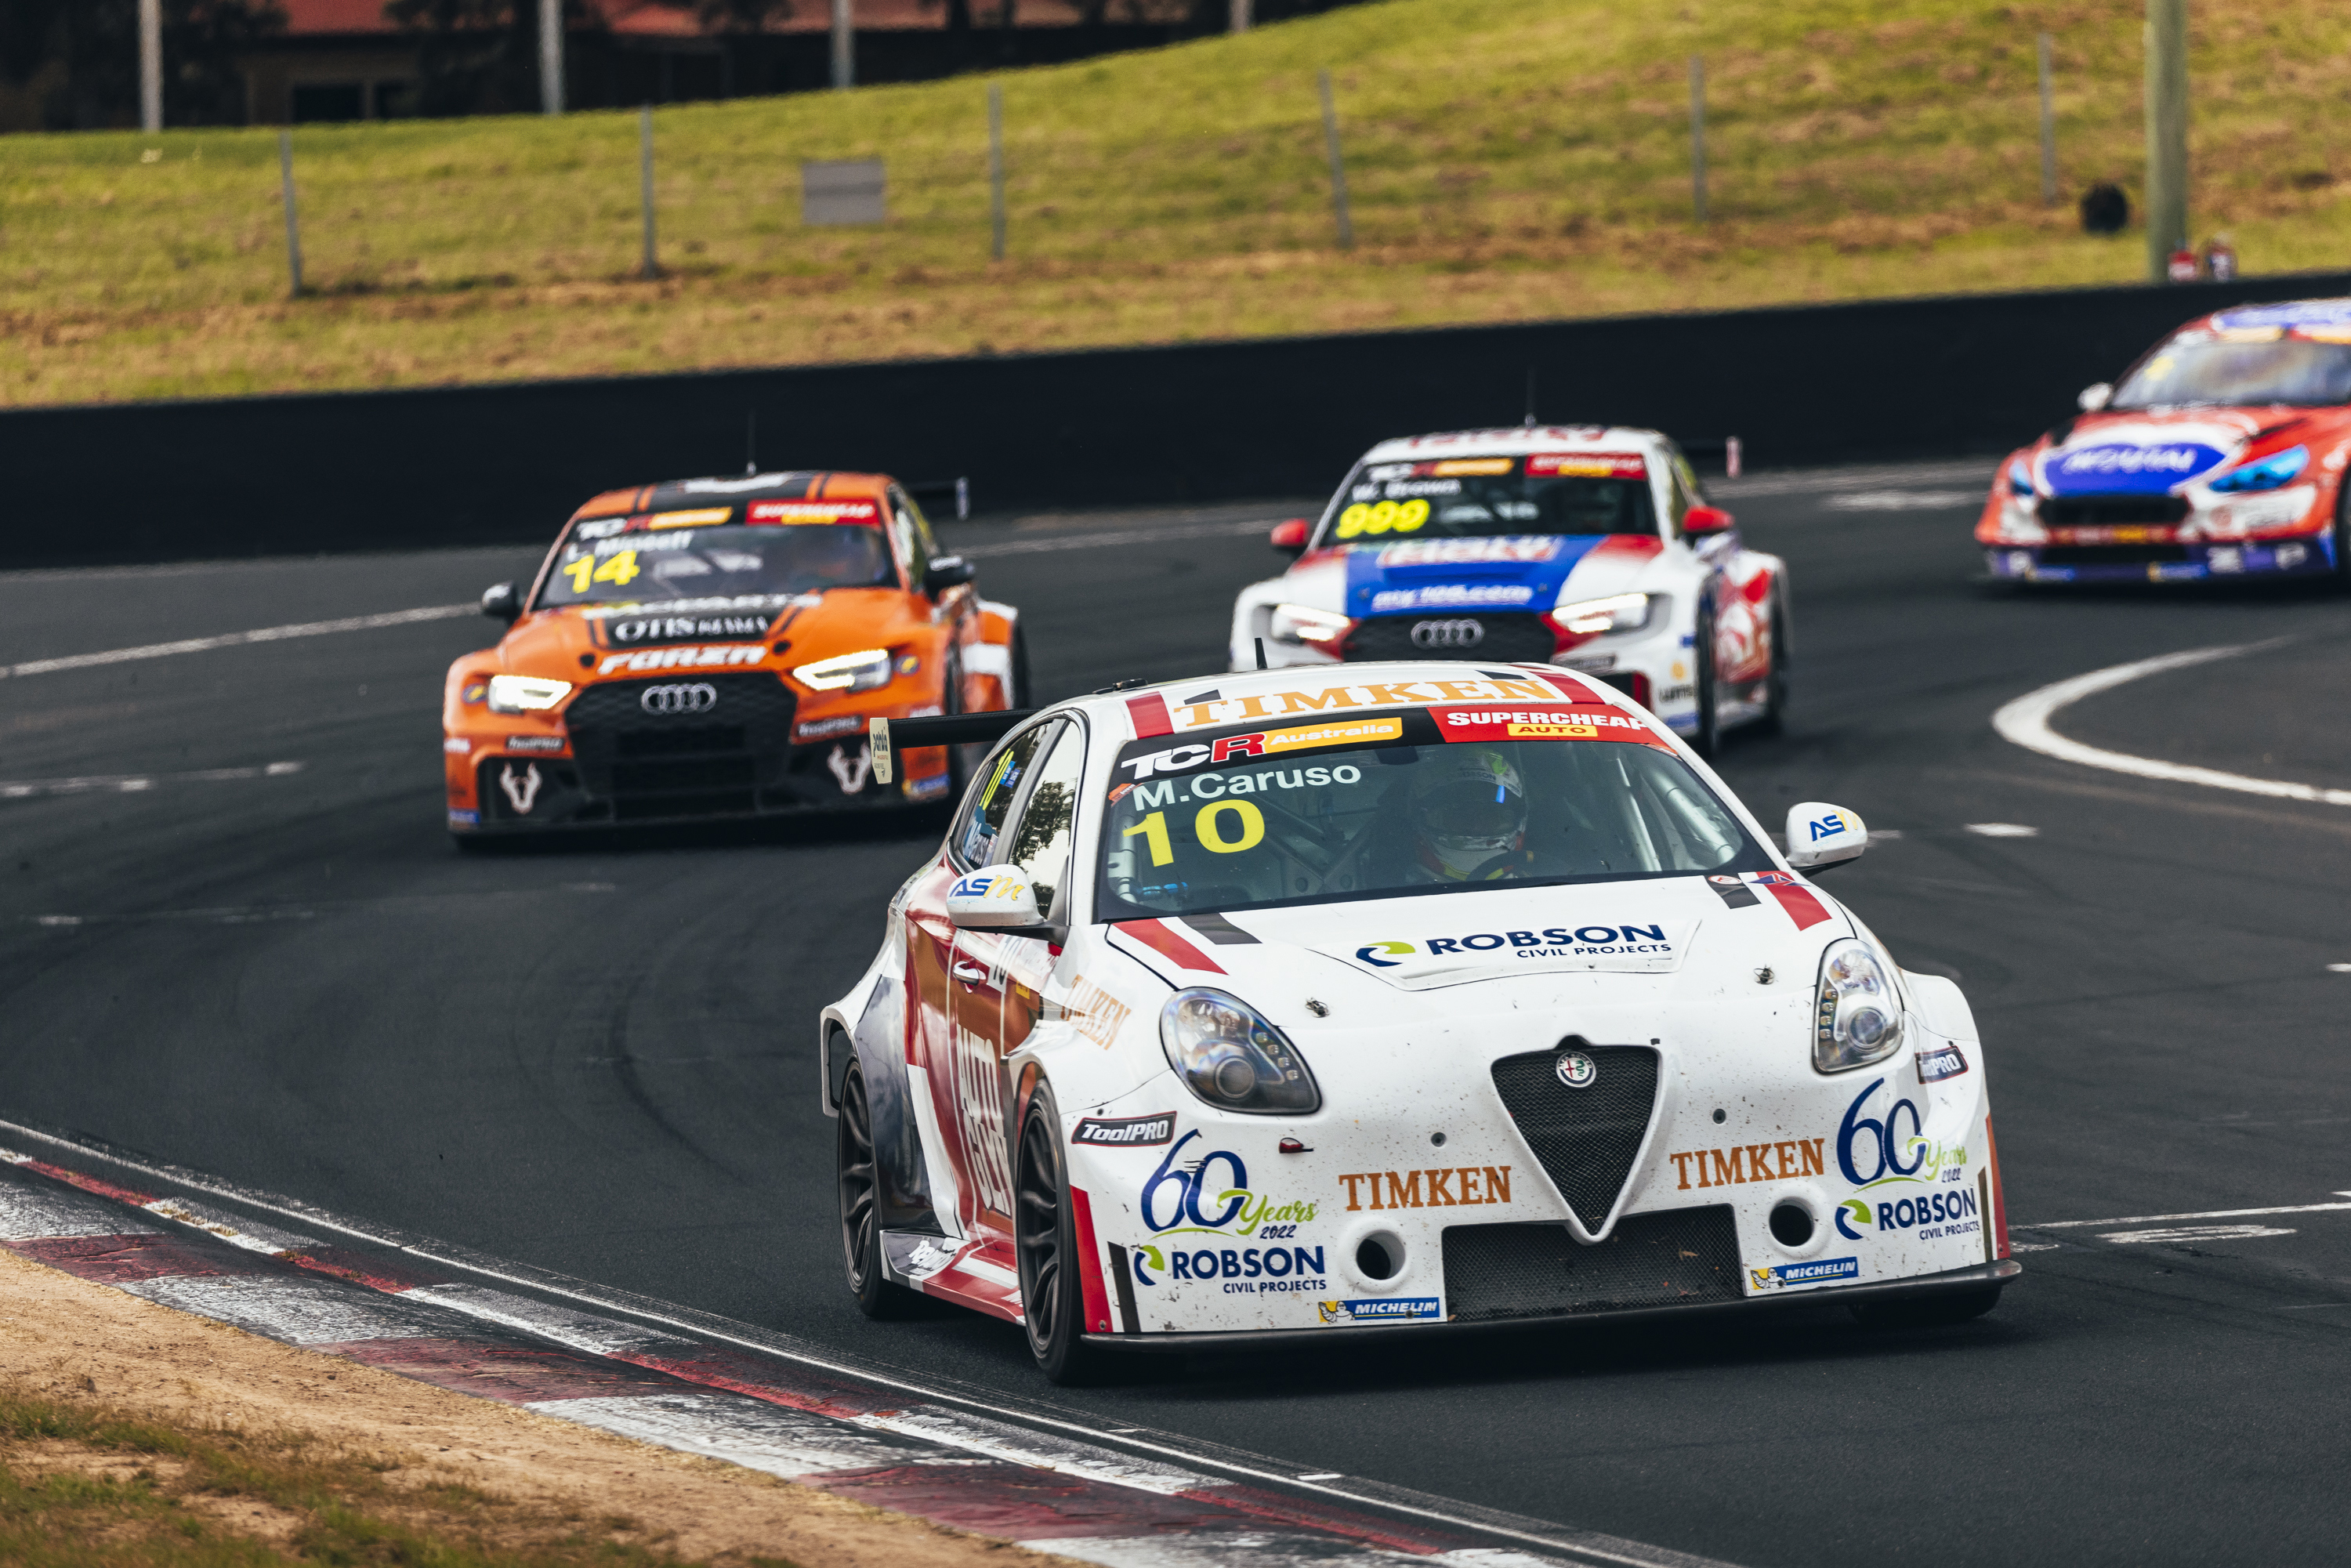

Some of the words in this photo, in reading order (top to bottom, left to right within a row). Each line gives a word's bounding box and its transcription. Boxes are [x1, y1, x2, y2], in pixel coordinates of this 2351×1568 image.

[1335, 498, 1430, 539] 999
[563, 549, 640, 593] 14
[1174, 680, 1557, 727] TIMKEN
[1447, 712, 1649, 730] SUPERCHEAP
[1519, 725, 1587, 735] AUTO
[1121, 732, 1268, 780] TCR
[1270, 723, 1394, 745] Australia
[1122, 799, 1266, 867] 10
[1425, 924, 1668, 955] ROBSON
[1516, 946, 1567, 958] CIVIL
[1574, 943, 1672, 956] PROJECTS
[1081, 1119, 1169, 1143] ToolPRO
[1837, 1077, 1926, 1186] 60
[1141, 1128, 1249, 1233] 60
[1670, 1138, 1826, 1190] TIMKEN
[1339, 1165, 1512, 1212] TIMKEN
[1216, 1189, 1320, 1237] Years
[1878, 1188, 1978, 1231] ROBSON
[1259, 1224, 1297, 1240] 2022
[1919, 1227, 1943, 1240] CIVIL
[1945, 1220, 1980, 1236] PROJECTS
[1173, 1245, 1325, 1280] ROBSON
[1785, 1261, 1857, 1279] MICHELIN
[1223, 1281, 1257, 1295] CIVIL
[1260, 1279, 1327, 1292] PROJECTS
[1353, 1301, 1438, 1316] MICHELIN
